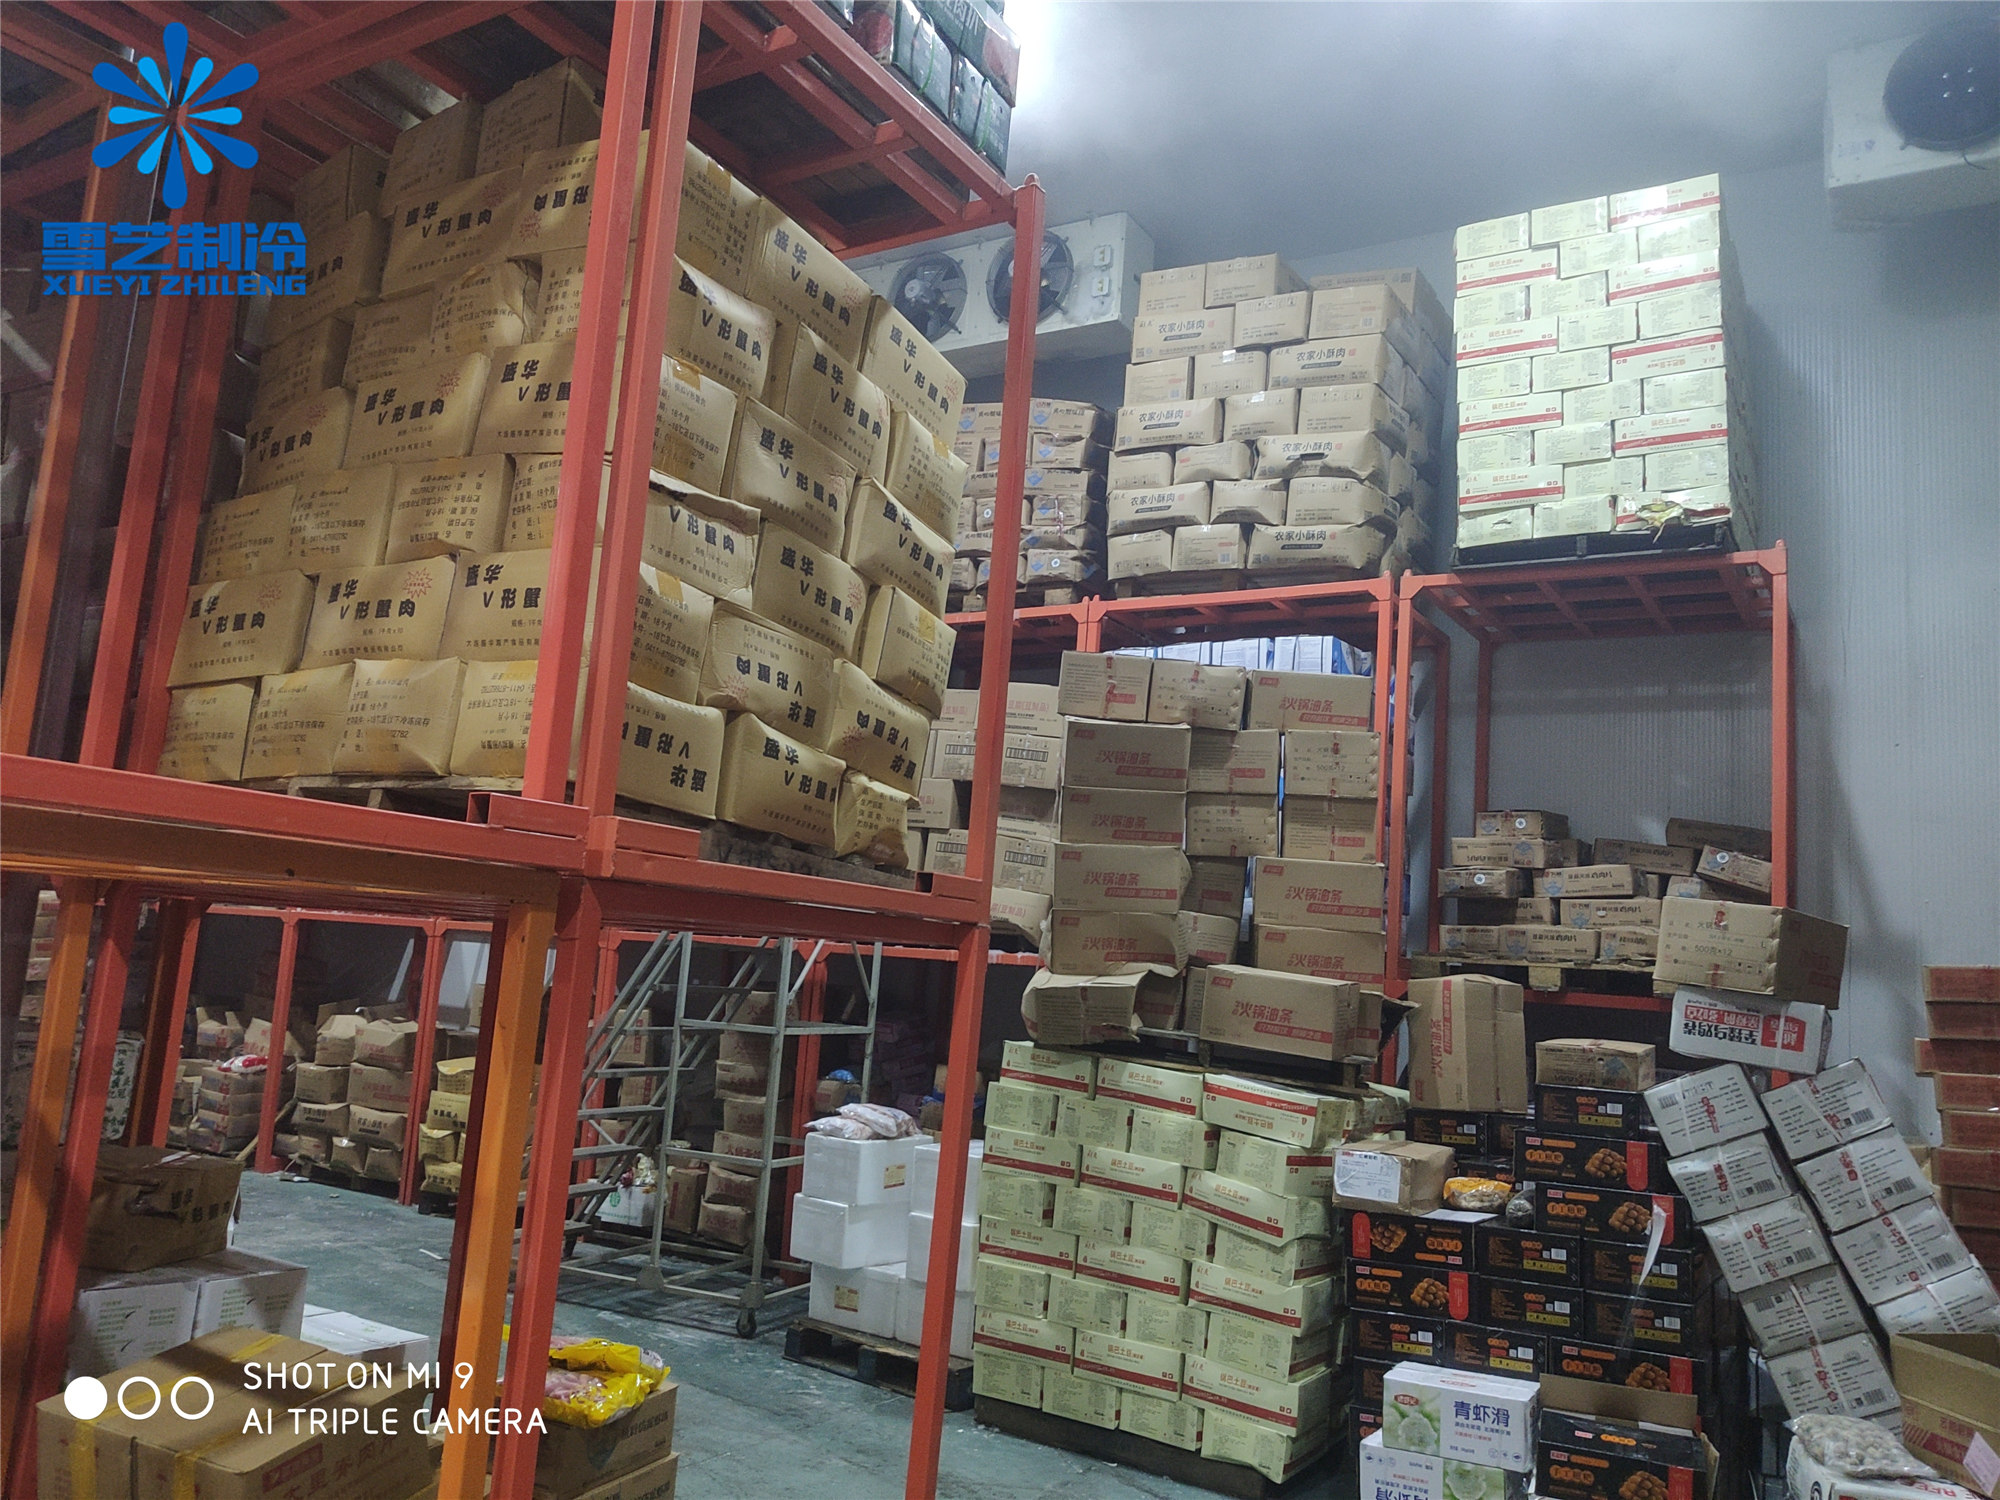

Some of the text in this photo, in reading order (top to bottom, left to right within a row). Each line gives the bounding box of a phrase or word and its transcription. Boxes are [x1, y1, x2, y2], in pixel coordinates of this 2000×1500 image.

[774, 228, 808, 266] 盛华
[791, 265, 851, 327] V形蟹肉
[702, 309, 762, 362] V形蟹肉
[812, 351, 844, 386] 盛华
[518, 381, 572, 403] V形蟹
[903, 359, 949, 415] V形蟹肉
[830, 387, 882, 440] V形蟹肉
[759, 426, 794, 461] 盛华
[779, 463, 838, 513] V形蟹肉
[668, 504, 735, 555] V形蟹肉
[882, 500, 913, 533] 盛华
[1274, 529, 1327, 543] 农家小酥肉
[780, 545, 814, 577] 盛华
[898, 533, 944, 582] V形蟹肉
[464, 564, 504, 588] 盛华
[339, 599, 416, 620] V形蟹肉
[483, 587, 542, 609] V形蟹
[799, 580, 854, 625] V形蟹肉
[736, 654, 803, 697] V形蟹肉
[1285, 698, 1334, 713] 火锅油条
[856, 709, 909, 751] V形蟹肉
[763, 736, 800, 766] 盛华
[669, 764, 708, 793] 盛华
[1291, 887, 1344, 904] 火锅油条
[1239, 1000, 1294, 1024] 火锅油条
[1453, 1400, 1511, 1428] 青虾滑
